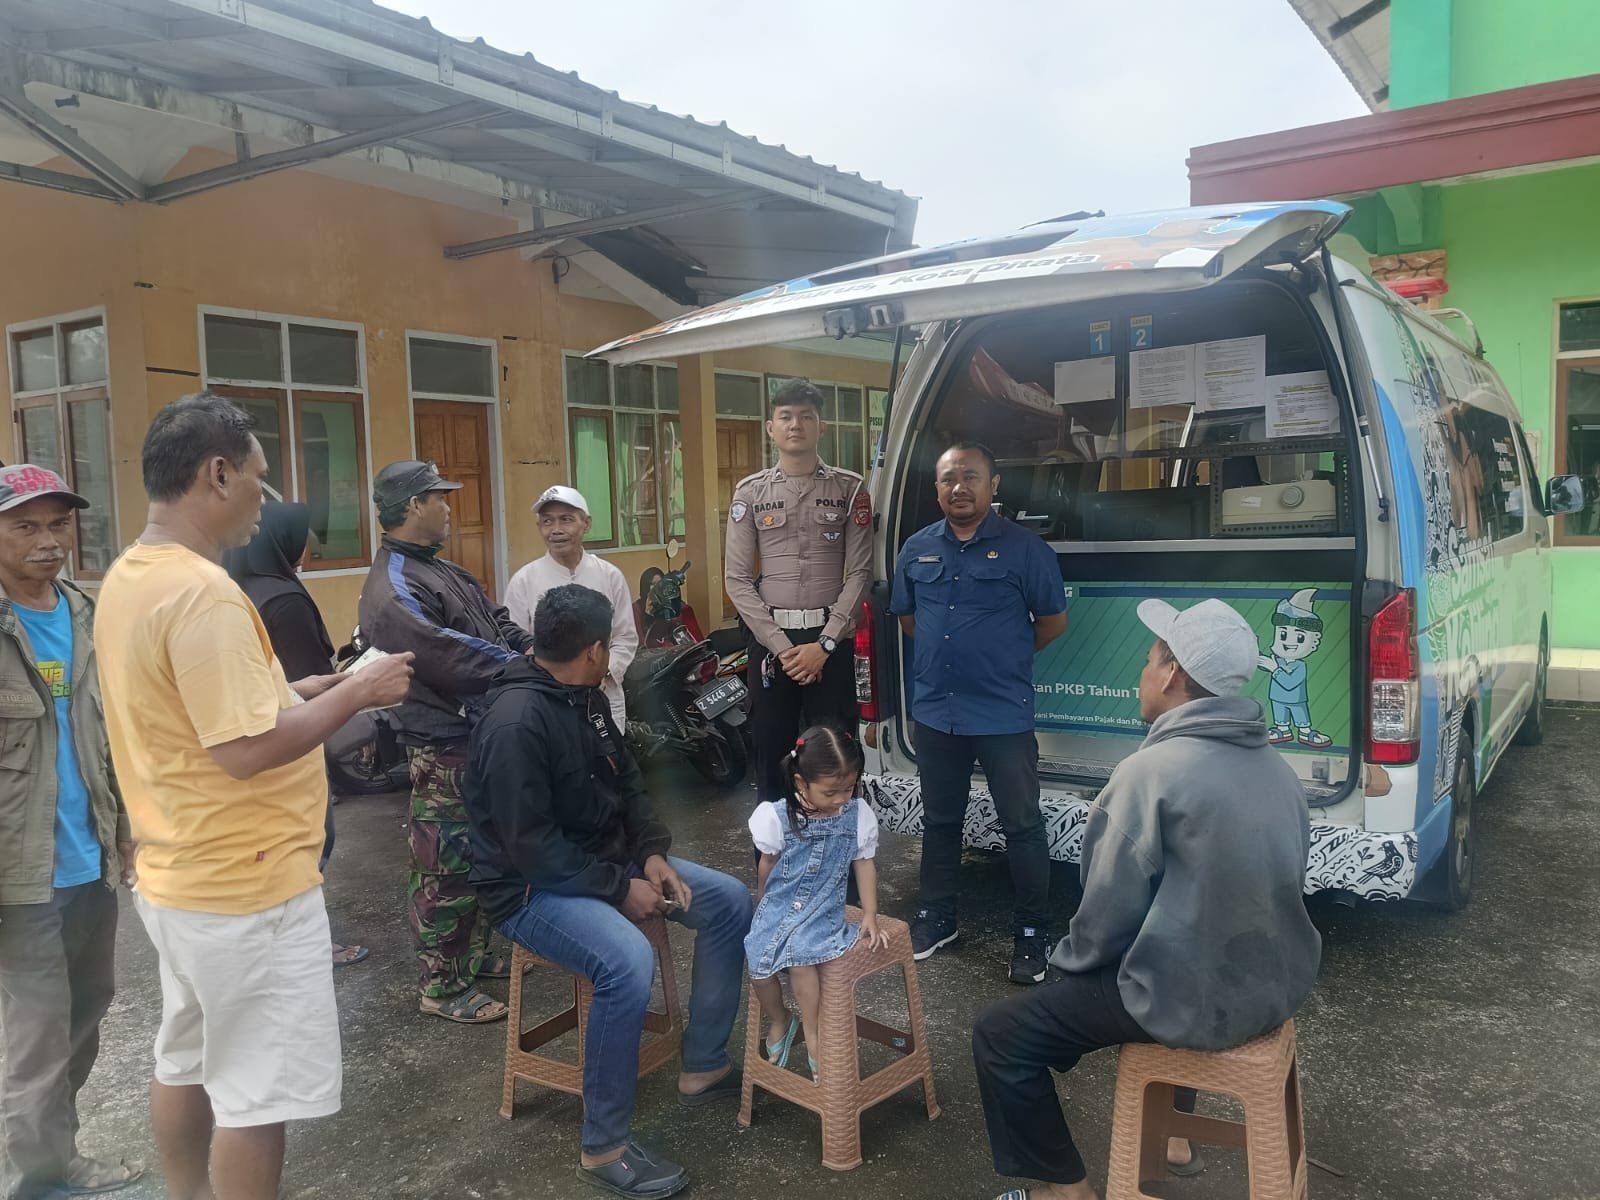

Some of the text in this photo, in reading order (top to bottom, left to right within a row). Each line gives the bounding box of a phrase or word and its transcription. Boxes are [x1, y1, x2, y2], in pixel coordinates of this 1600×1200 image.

[889, 265, 973, 286] Kota
[981, 253, 1097, 274] Ditata
[1095, 333, 1103, 351] 1
[1136, 329, 1146, 346] 2
[706, 689, 726, 705] 5446
[1055, 683, 1085, 696] PKB
[1087, 684, 1130, 698] Tahun
[1048, 712, 1094, 722] Pembayaran
[1095, 715, 1115, 724] Pajak
[1116, 716, 1131, 725] dan
